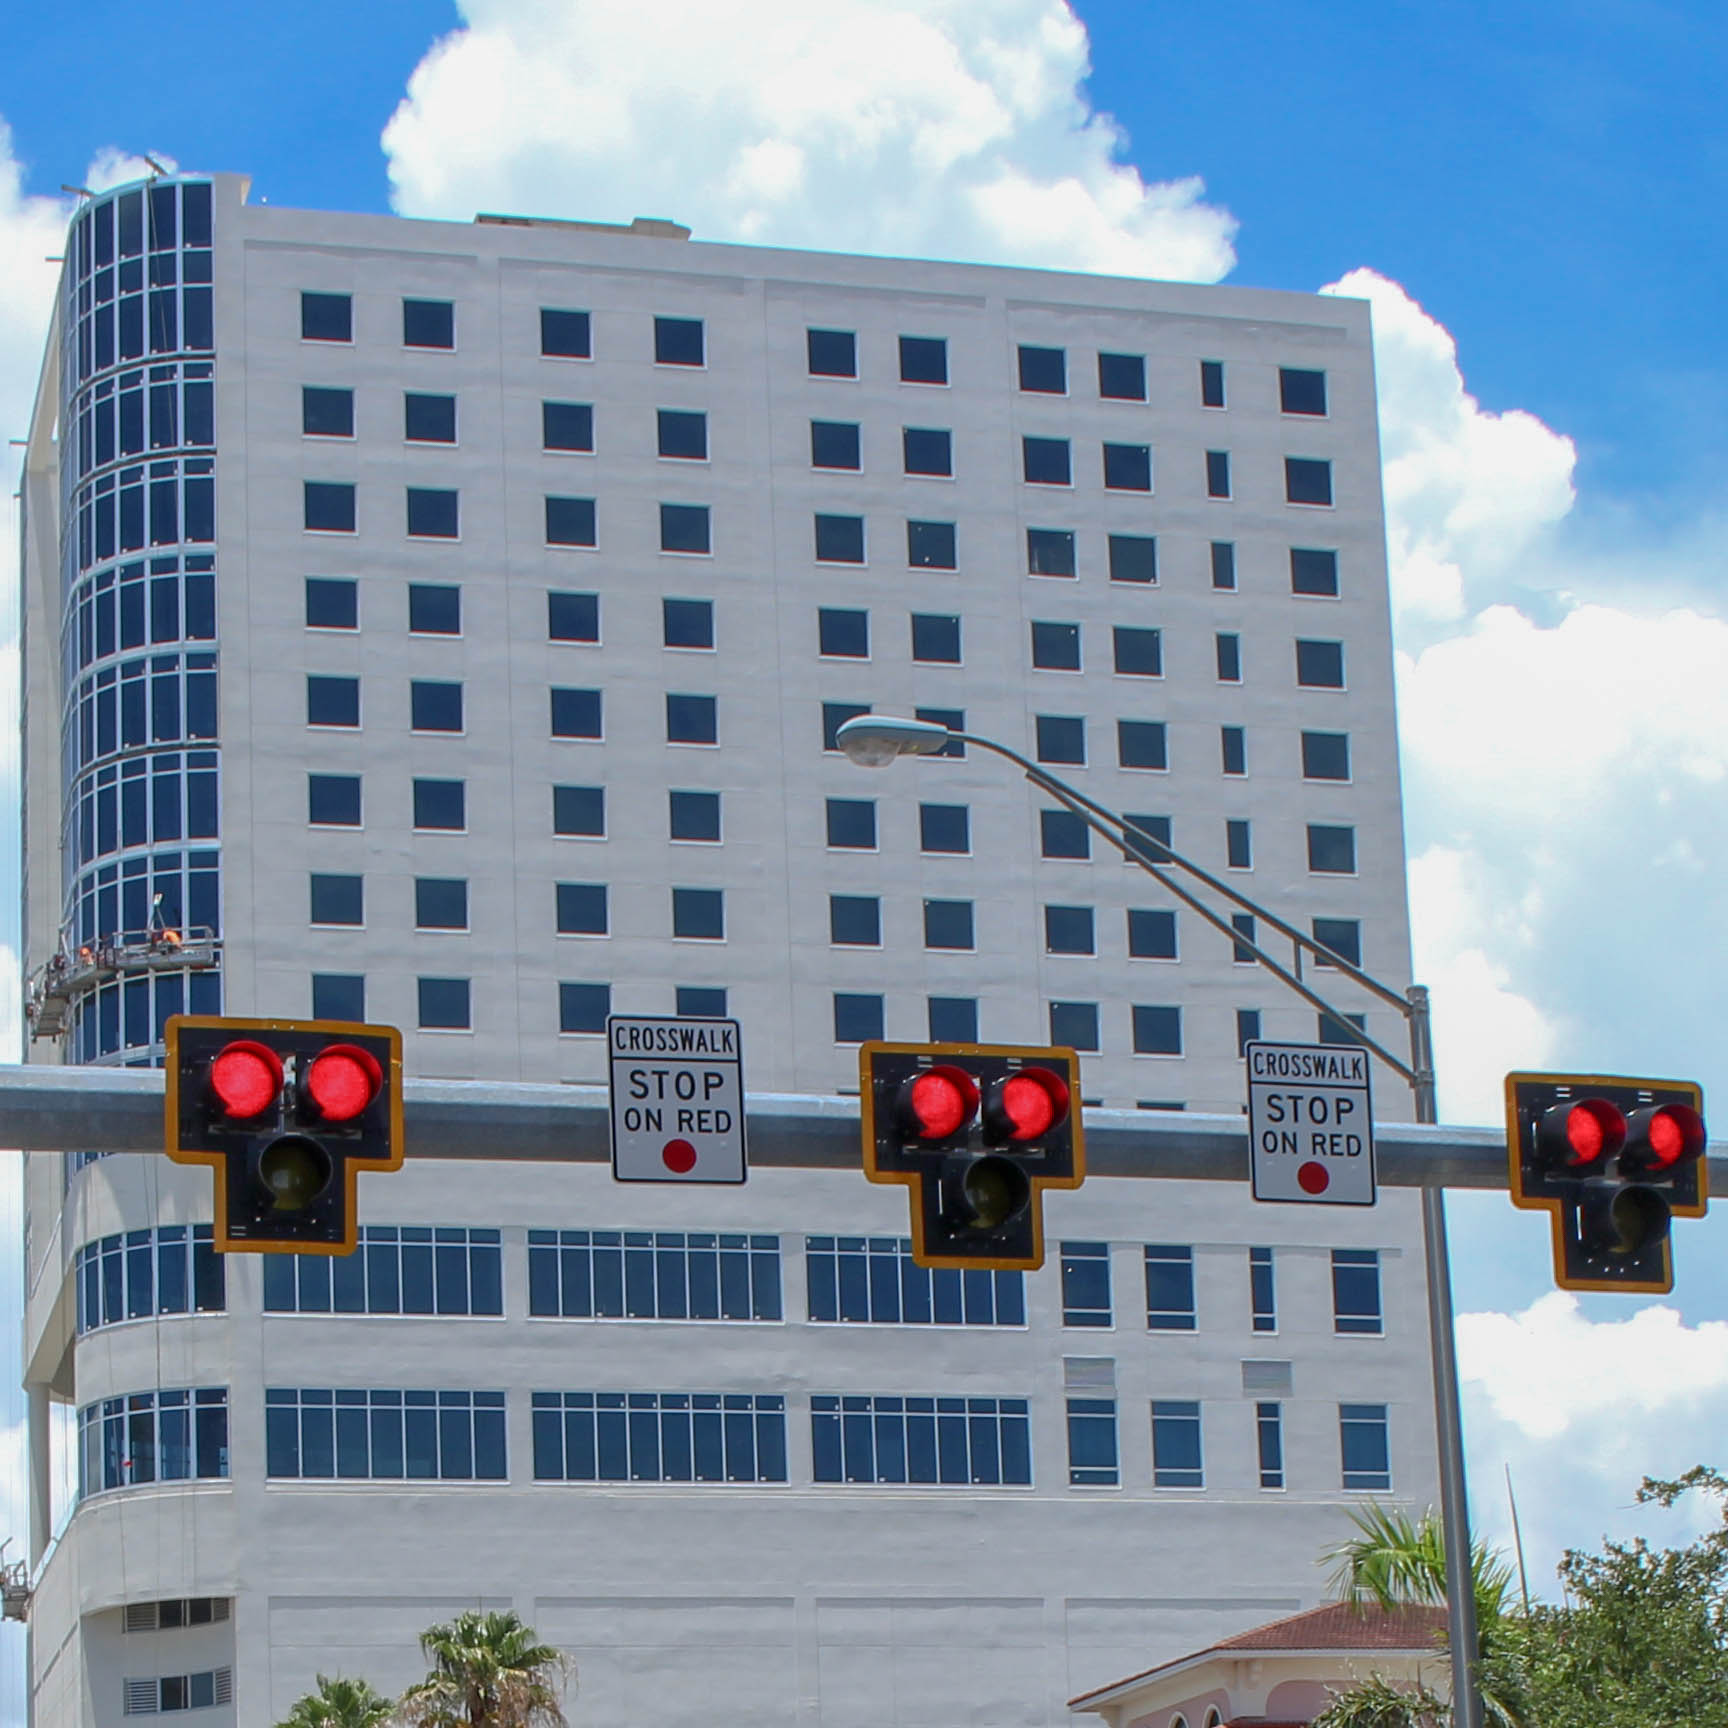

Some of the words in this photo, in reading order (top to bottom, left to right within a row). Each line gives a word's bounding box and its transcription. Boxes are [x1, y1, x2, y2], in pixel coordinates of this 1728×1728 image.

[615, 1026, 734, 1053] CROSSWALK
[1253, 1052, 1363, 1080] CROSSWALK
[629, 1069, 724, 1101] STOP
[624, 1107, 663, 1132] ON
[677, 1109, 732, 1134] RED
[1266, 1093, 1354, 1125] STOP
[1262, 1130, 1298, 1154] ON
[1311, 1132, 1362, 1157] RED
